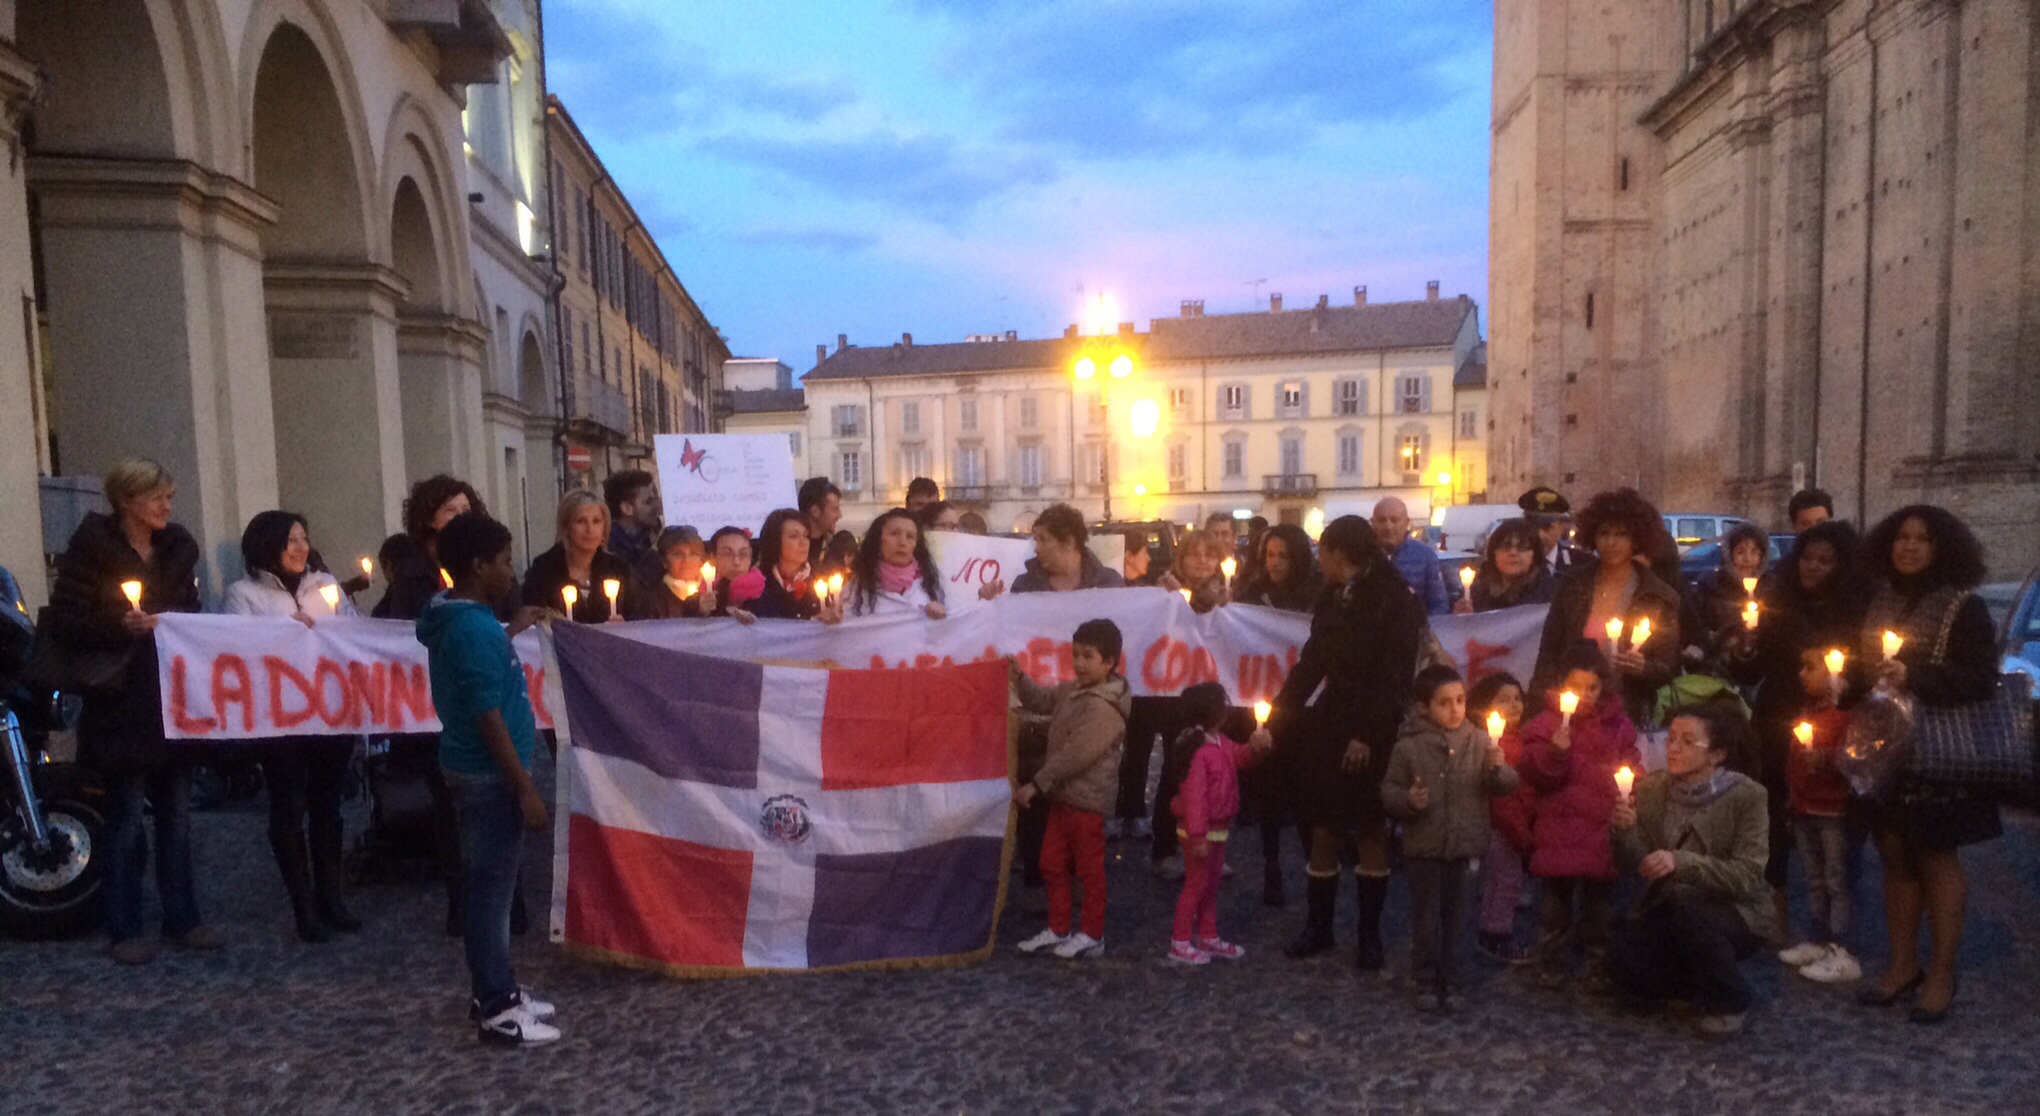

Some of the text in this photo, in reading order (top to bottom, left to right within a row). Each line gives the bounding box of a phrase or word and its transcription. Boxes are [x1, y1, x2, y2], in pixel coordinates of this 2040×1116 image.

[170, 653, 255, 734] LA
[263, 655, 437, 731] DONN
[1141, 634, 1219, 692] CON
